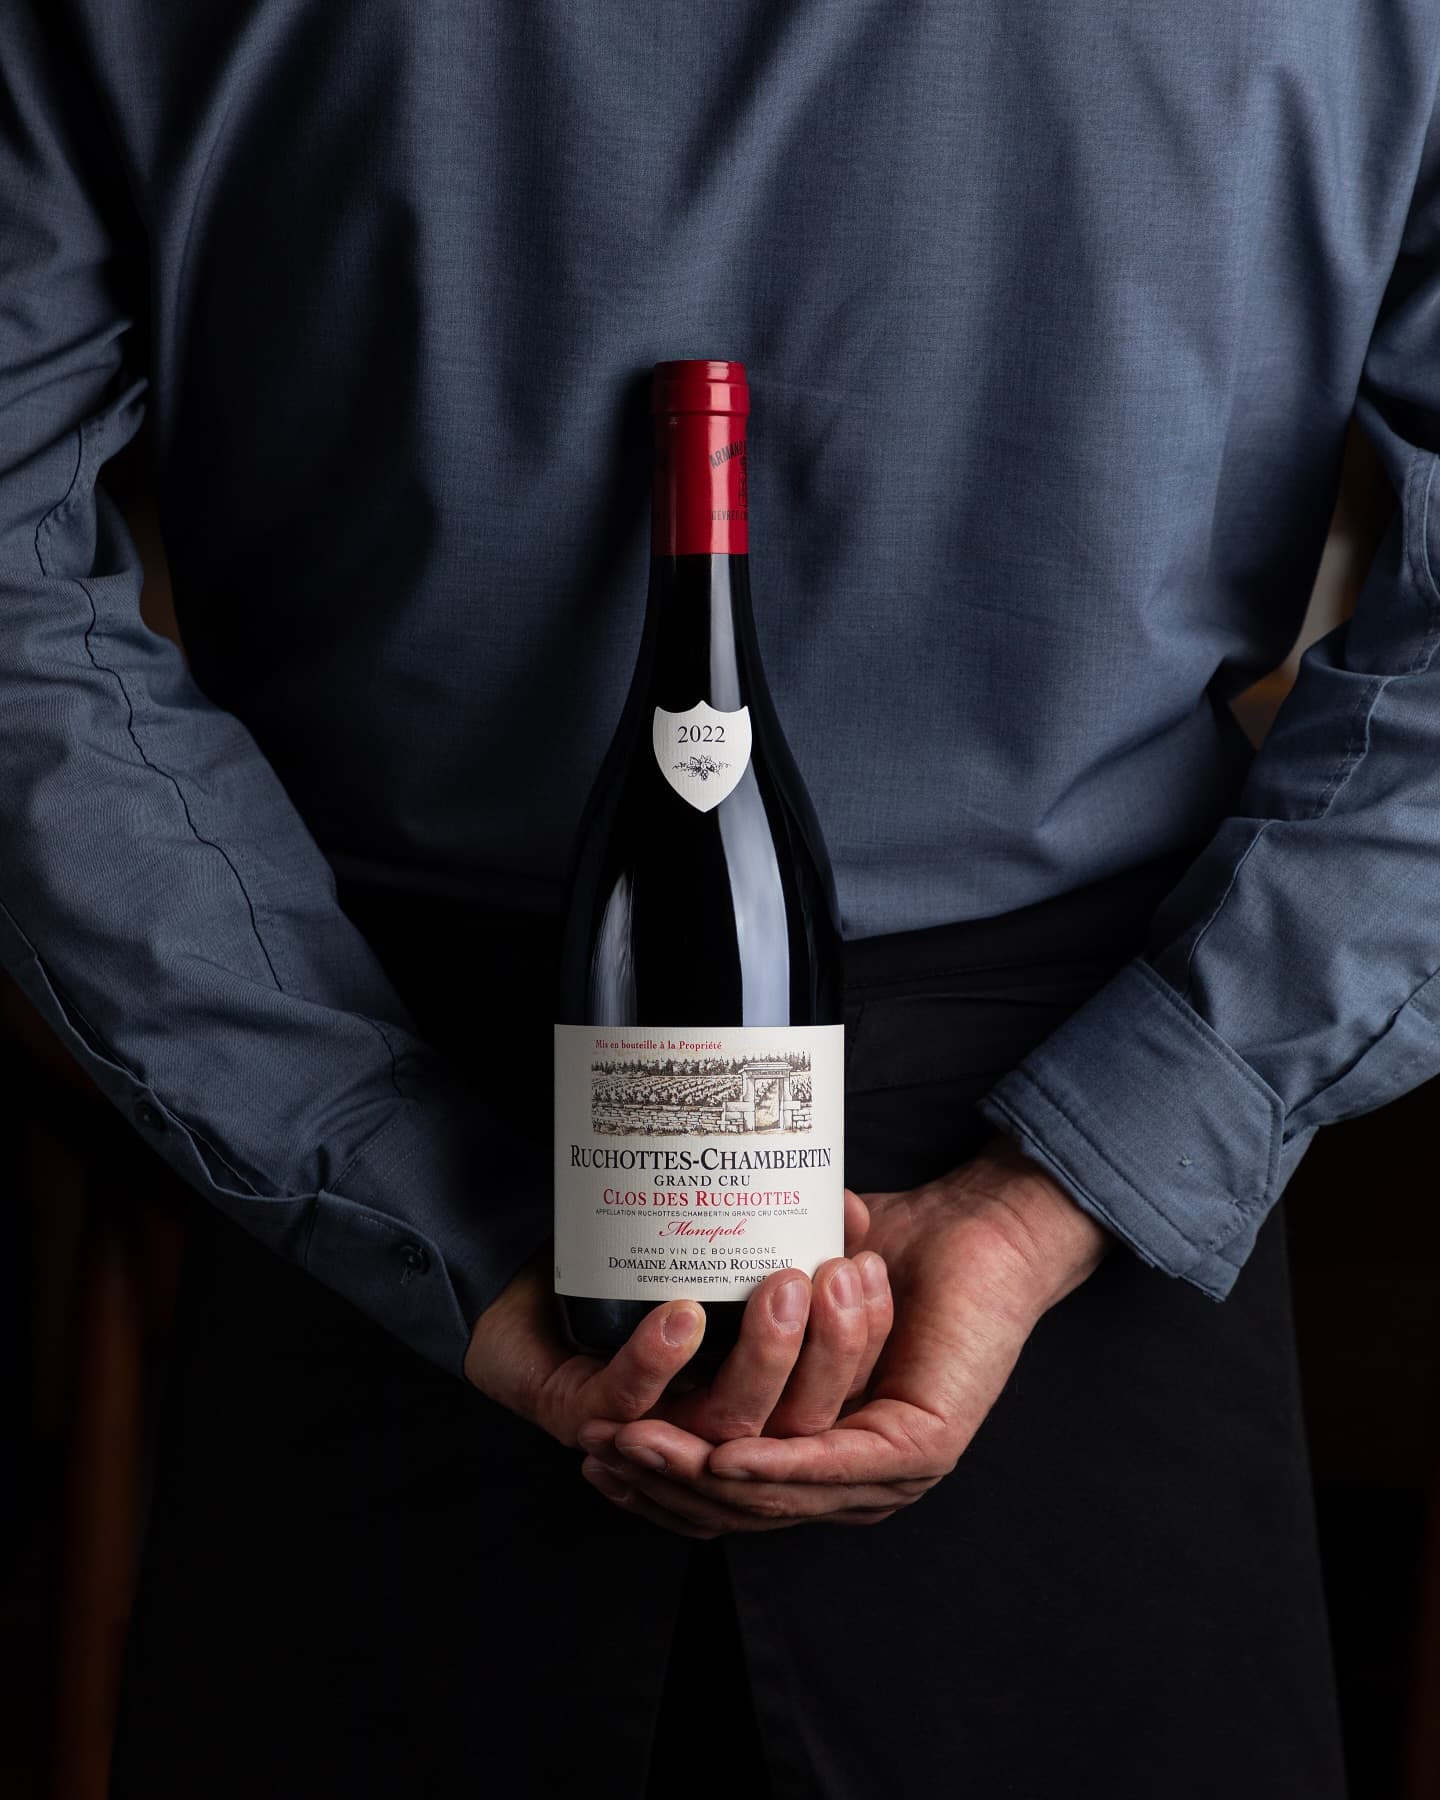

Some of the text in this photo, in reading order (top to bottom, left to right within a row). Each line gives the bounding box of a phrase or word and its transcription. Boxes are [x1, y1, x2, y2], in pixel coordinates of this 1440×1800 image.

[677, 725, 726, 744] 2022
[595, 1039, 609, 1049] Mis
[621, 1039, 658, 1050] bouteille
[660, 1040, 665, 1050] à
[667, 1040, 676, 1050] la
[679, 1040, 722, 1052] Propriété
[570, 1144, 832, 1170] RUCHOTTES-CHAMBERTIN
[654, 1175, 751, 1187] GRAND CRU
[603, 1188, 801, 1207] CLOS DES RUCHOTTES
[595, 1208, 636, 1216] APPELLATION
[731, 1209, 757, 1217] GRAND
[658, 1218, 747, 1243] Monopole
[630, 1246, 777, 1255] GRAND VIN DE BOURGOGNE
[608, 1256, 793, 1271] DOMAINE ARMAND ROUSSEAU
[637, 1275, 732, 1284] GEVREY-CHAMBERTIN,
